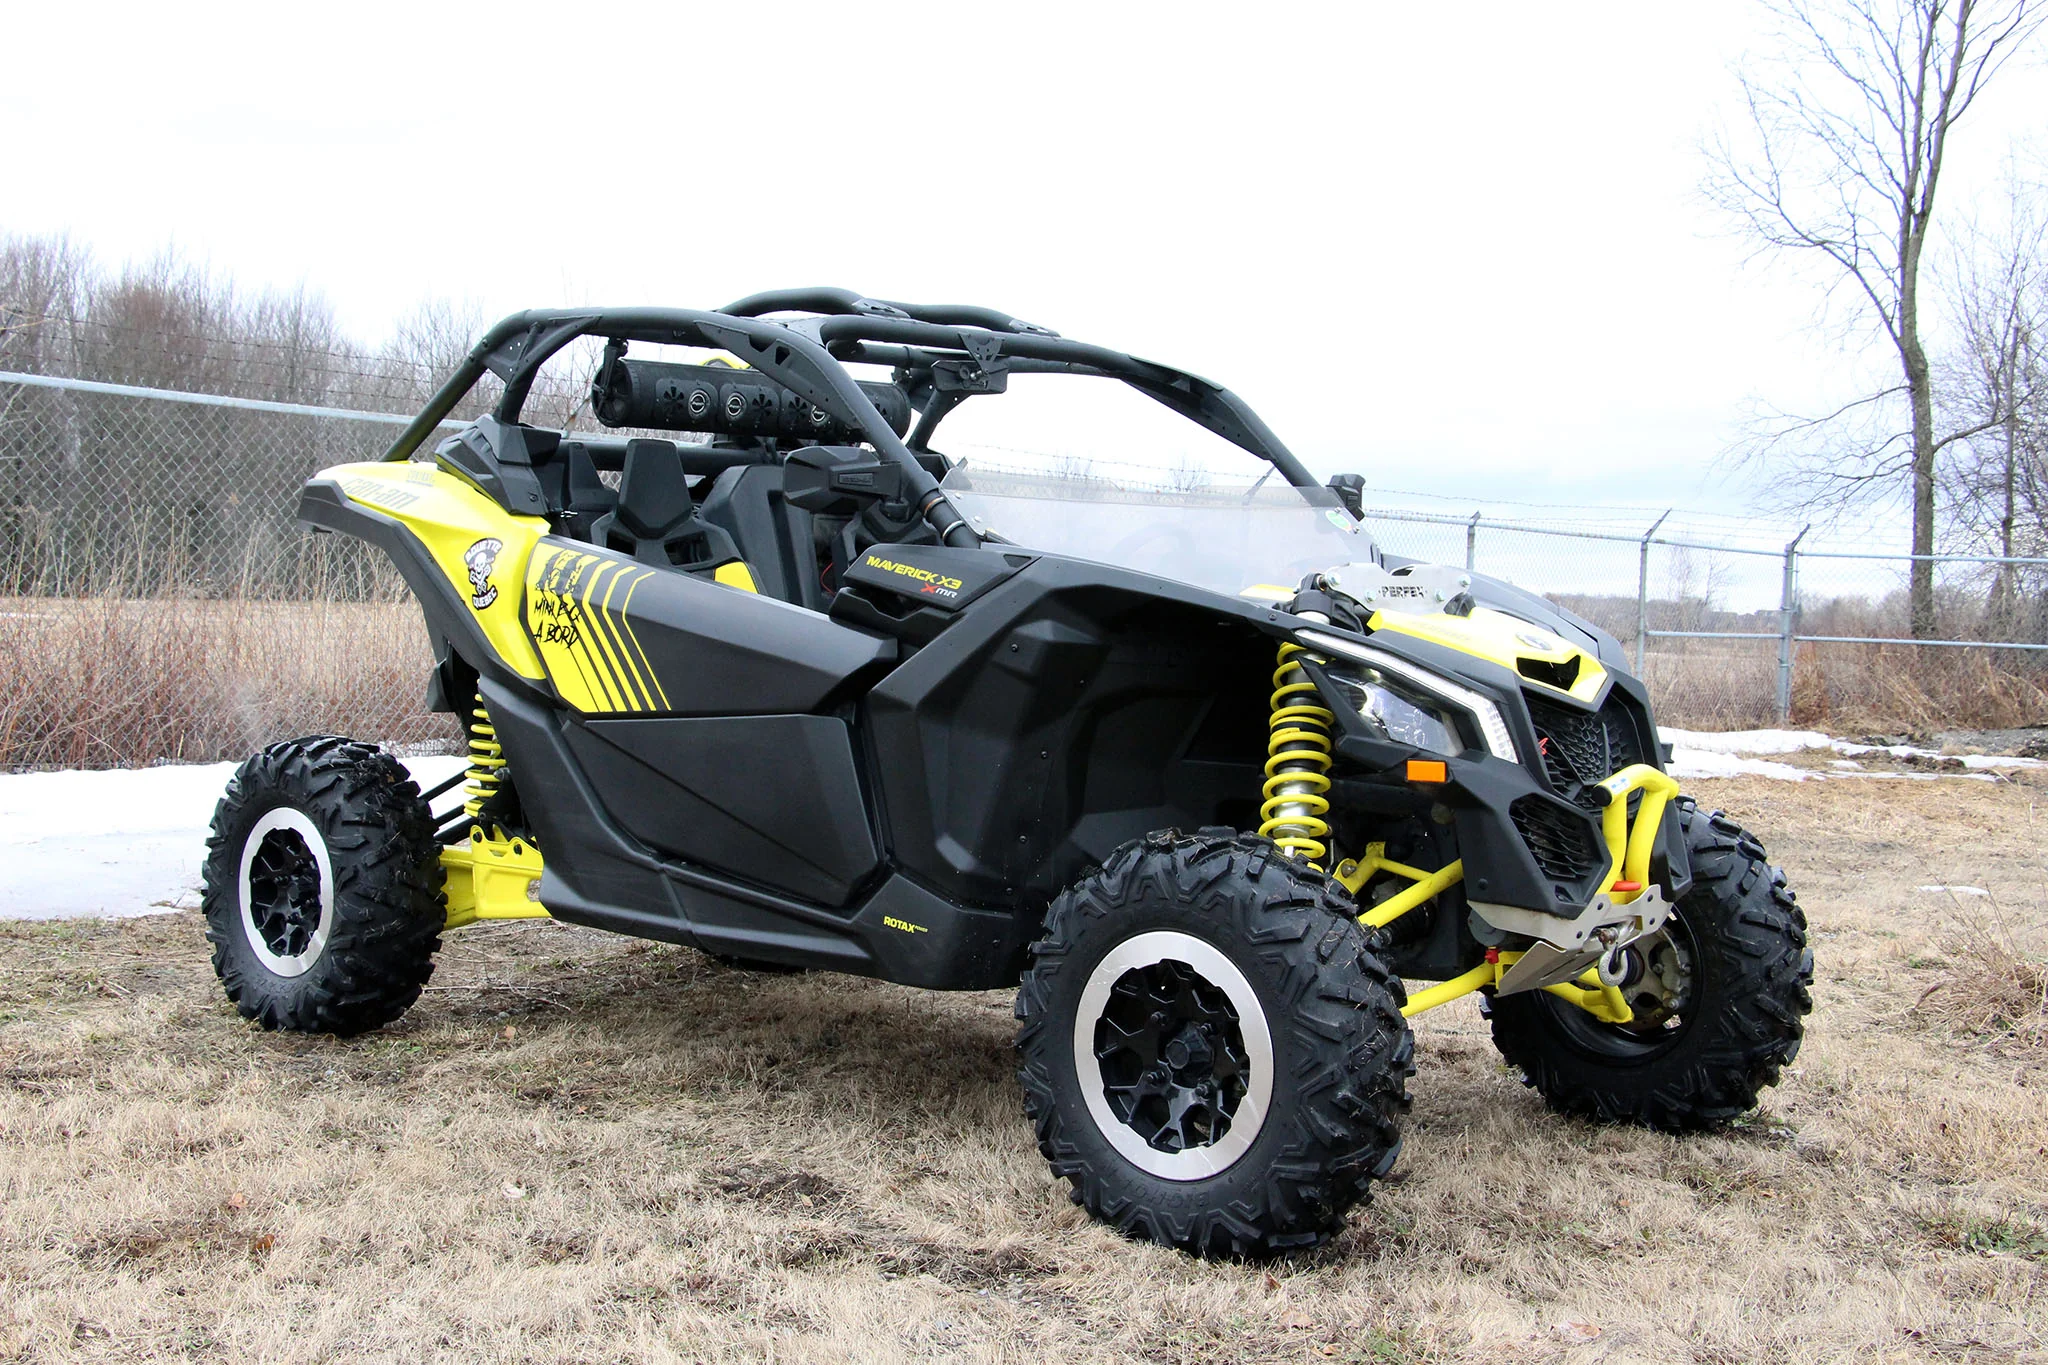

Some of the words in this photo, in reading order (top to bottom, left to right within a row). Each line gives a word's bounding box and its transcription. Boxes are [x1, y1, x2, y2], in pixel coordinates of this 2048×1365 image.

[866, 556, 938, 583] MAVERICK
[936, 576, 962, 590] X3
[544, 623, 579, 648] BORD
[883, 916, 915, 933] ROTAX
